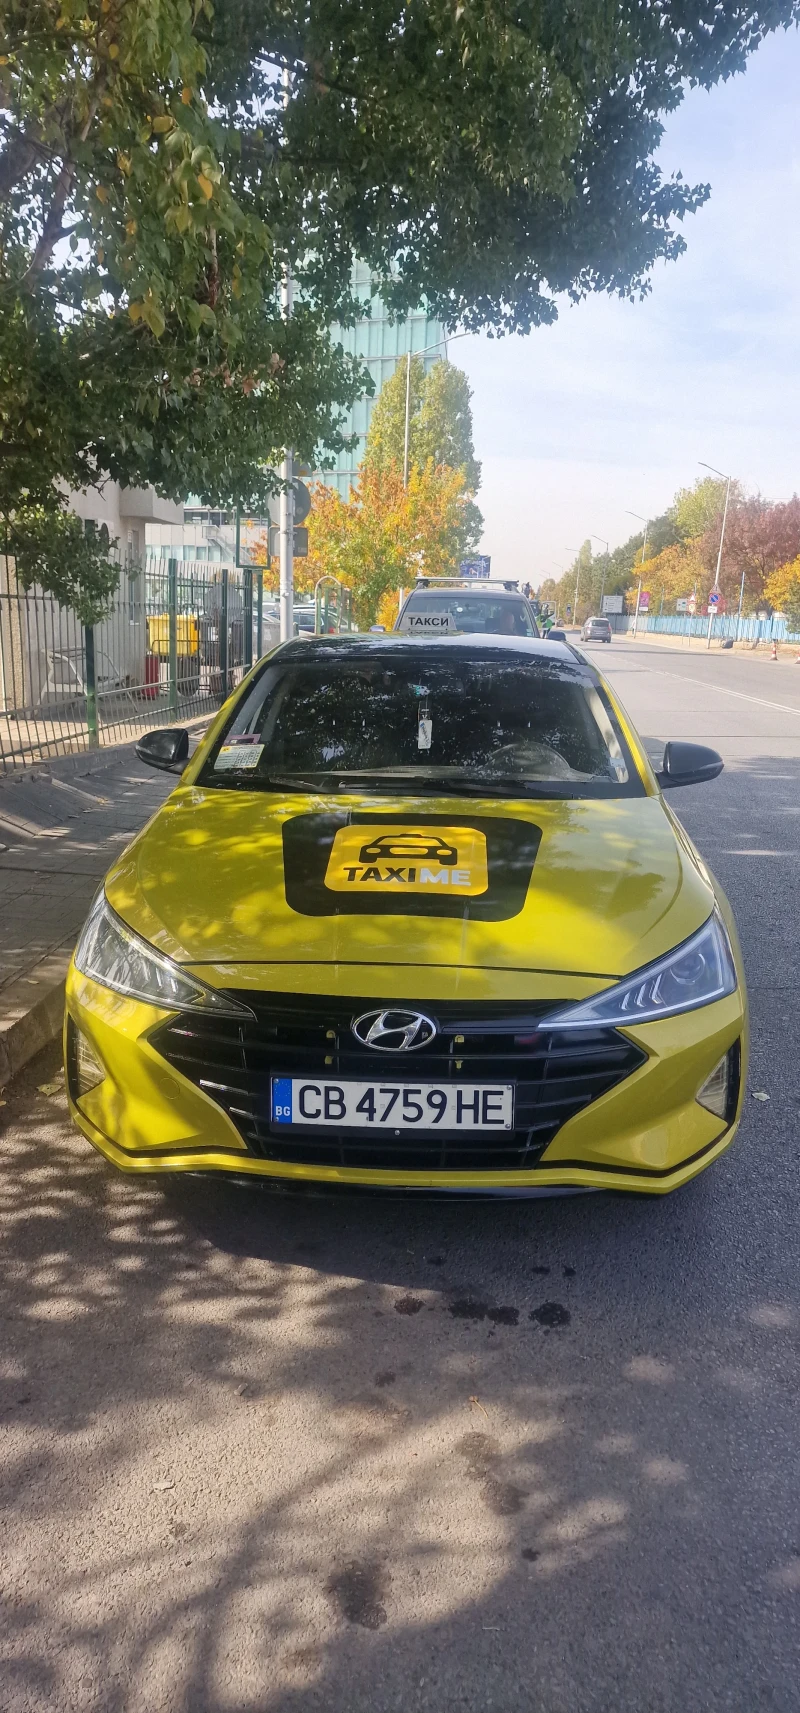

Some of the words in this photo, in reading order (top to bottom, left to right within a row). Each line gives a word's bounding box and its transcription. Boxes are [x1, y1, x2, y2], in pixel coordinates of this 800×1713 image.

[408, 616, 449, 627] ТАКСИ
[275, 1105, 291, 1117] BG
[299, 1085, 347, 1120] CB
[356, 1088, 448, 1123] 4759
[456, 1090, 505, 1125] HE
